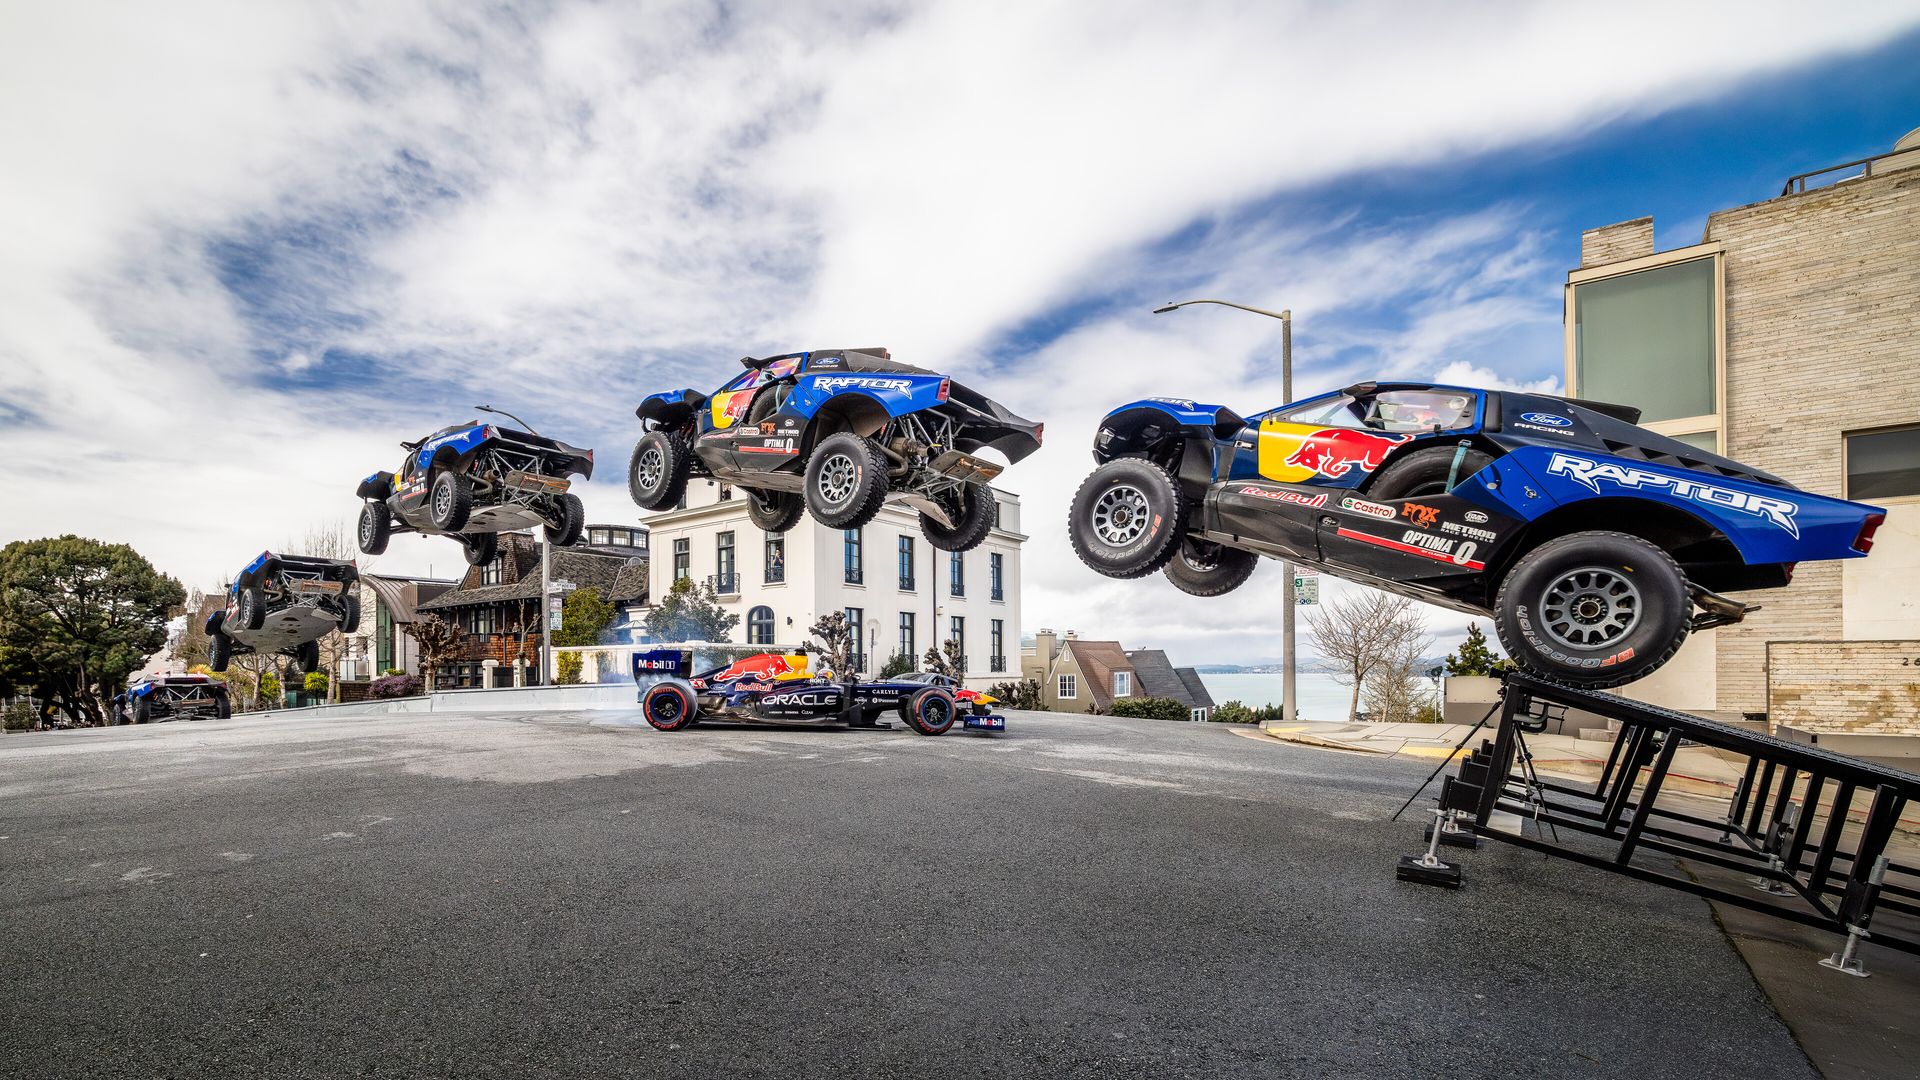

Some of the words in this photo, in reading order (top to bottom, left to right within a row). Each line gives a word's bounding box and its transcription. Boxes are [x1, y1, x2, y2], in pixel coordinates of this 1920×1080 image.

[813, 376, 912, 400] RAPTOR
[761, 422, 776, 436] FOX
[1514, 422, 1575, 436] RACING
[763, 438, 784, 448] OPTIMA
[1239, 486, 1284, 500] Red
[1280, 493, 1328, 508] Bull
[1546, 452, 1800, 540] RAPTOR
[1353, 501, 1393, 517] Castrol
[1401, 502, 1440, 529] FOX
[1441, 521, 1497, 540] METHOD
[1401, 530, 1453, 553] OPTIMA
[1516, 605, 1635, 668] BFGoodrich
[638, 659, 664, 670] Mobil
[735, 682, 753, 691] Red
[752, 682, 773, 691] Bull
[762, 694, 838, 706] ORACLE
[980, 718, 1003, 726] Mobil
